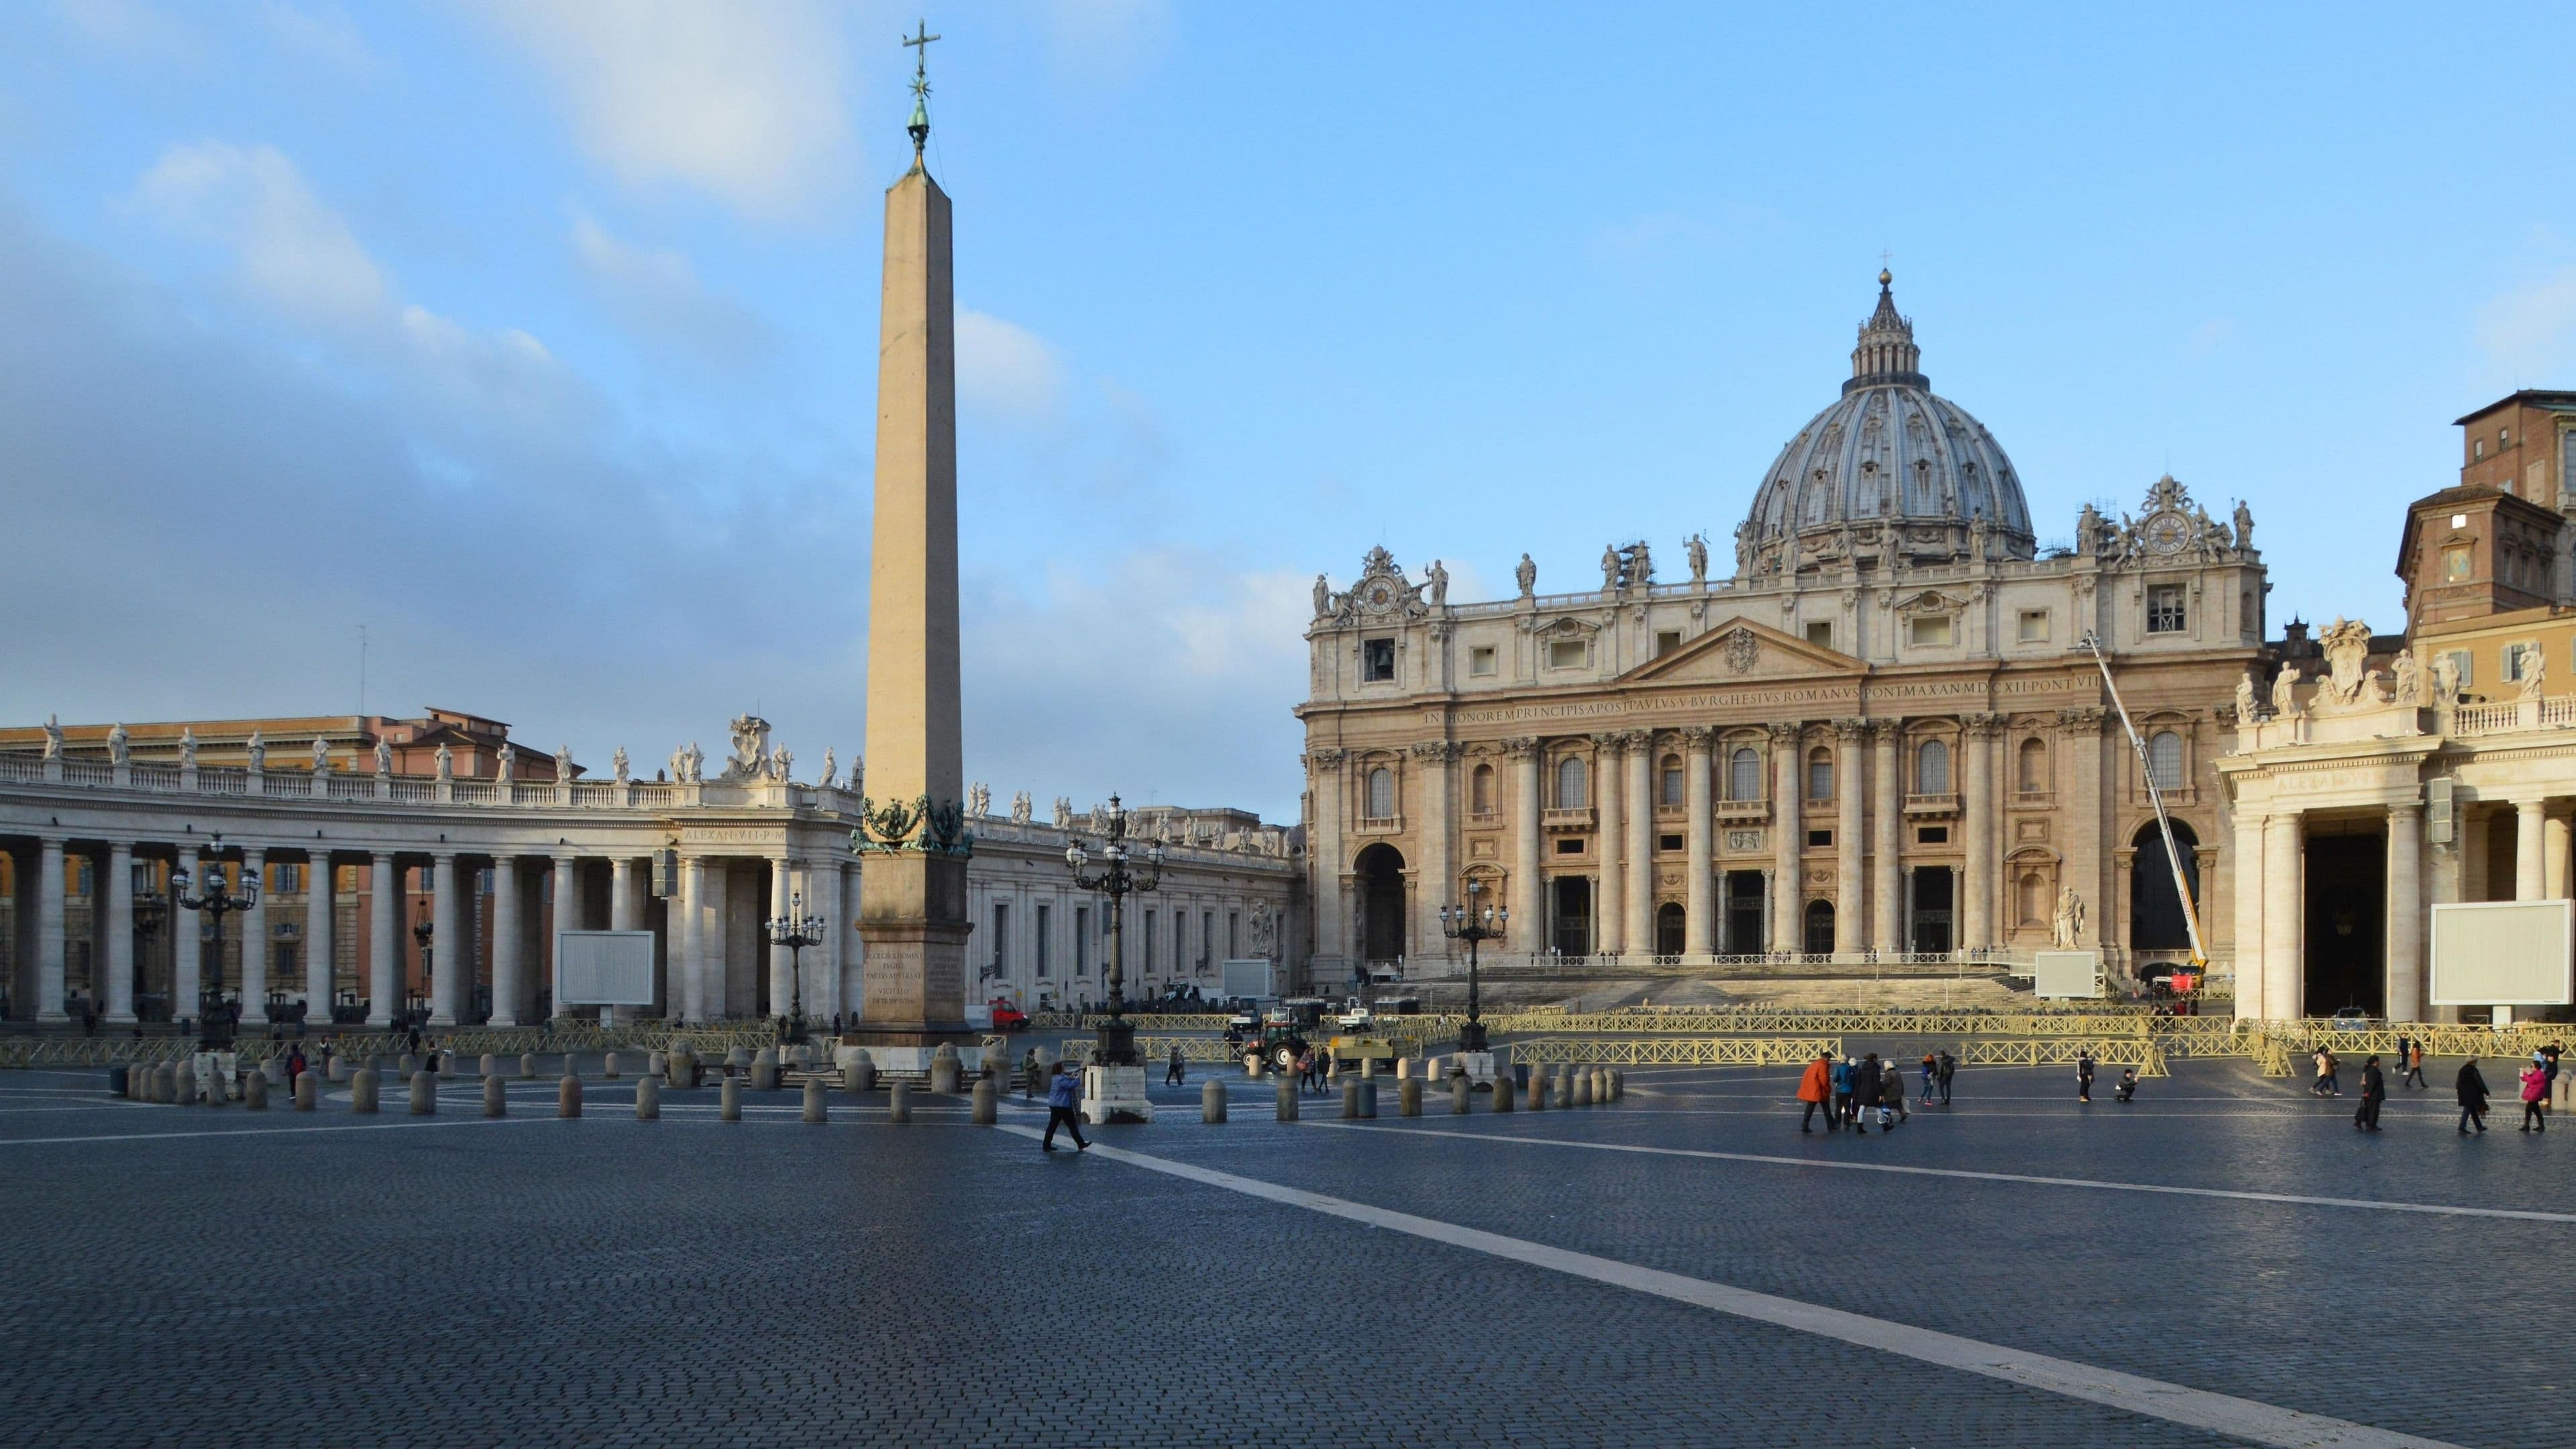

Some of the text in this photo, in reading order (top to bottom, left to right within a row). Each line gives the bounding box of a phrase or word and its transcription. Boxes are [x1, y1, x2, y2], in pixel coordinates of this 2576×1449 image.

[1424, 712, 1440, 724] IN
[1448, 710, 1515, 724] HONOREM
[1517, 704, 1585, 719] PRINCIPIS
[1587, 701, 1629, 714] APOST
[1629, 697, 1676, 710] PAVLVS
[1690, 692, 1780, 707] BVRGHESIVS
[1784, 687, 1860, 702] ROMANVS
[1864, 686, 1902, 699] PONT
[1903, 684, 1939, 698] MAX
[1963, 681, 2027, 694] MDCXII
[2031, 679, 2074, 693] PONT
[2077, 675, 2099, 688] VII
[685, 829, 733, 839] ALEXAN
[739, 830, 758, 839] VII
